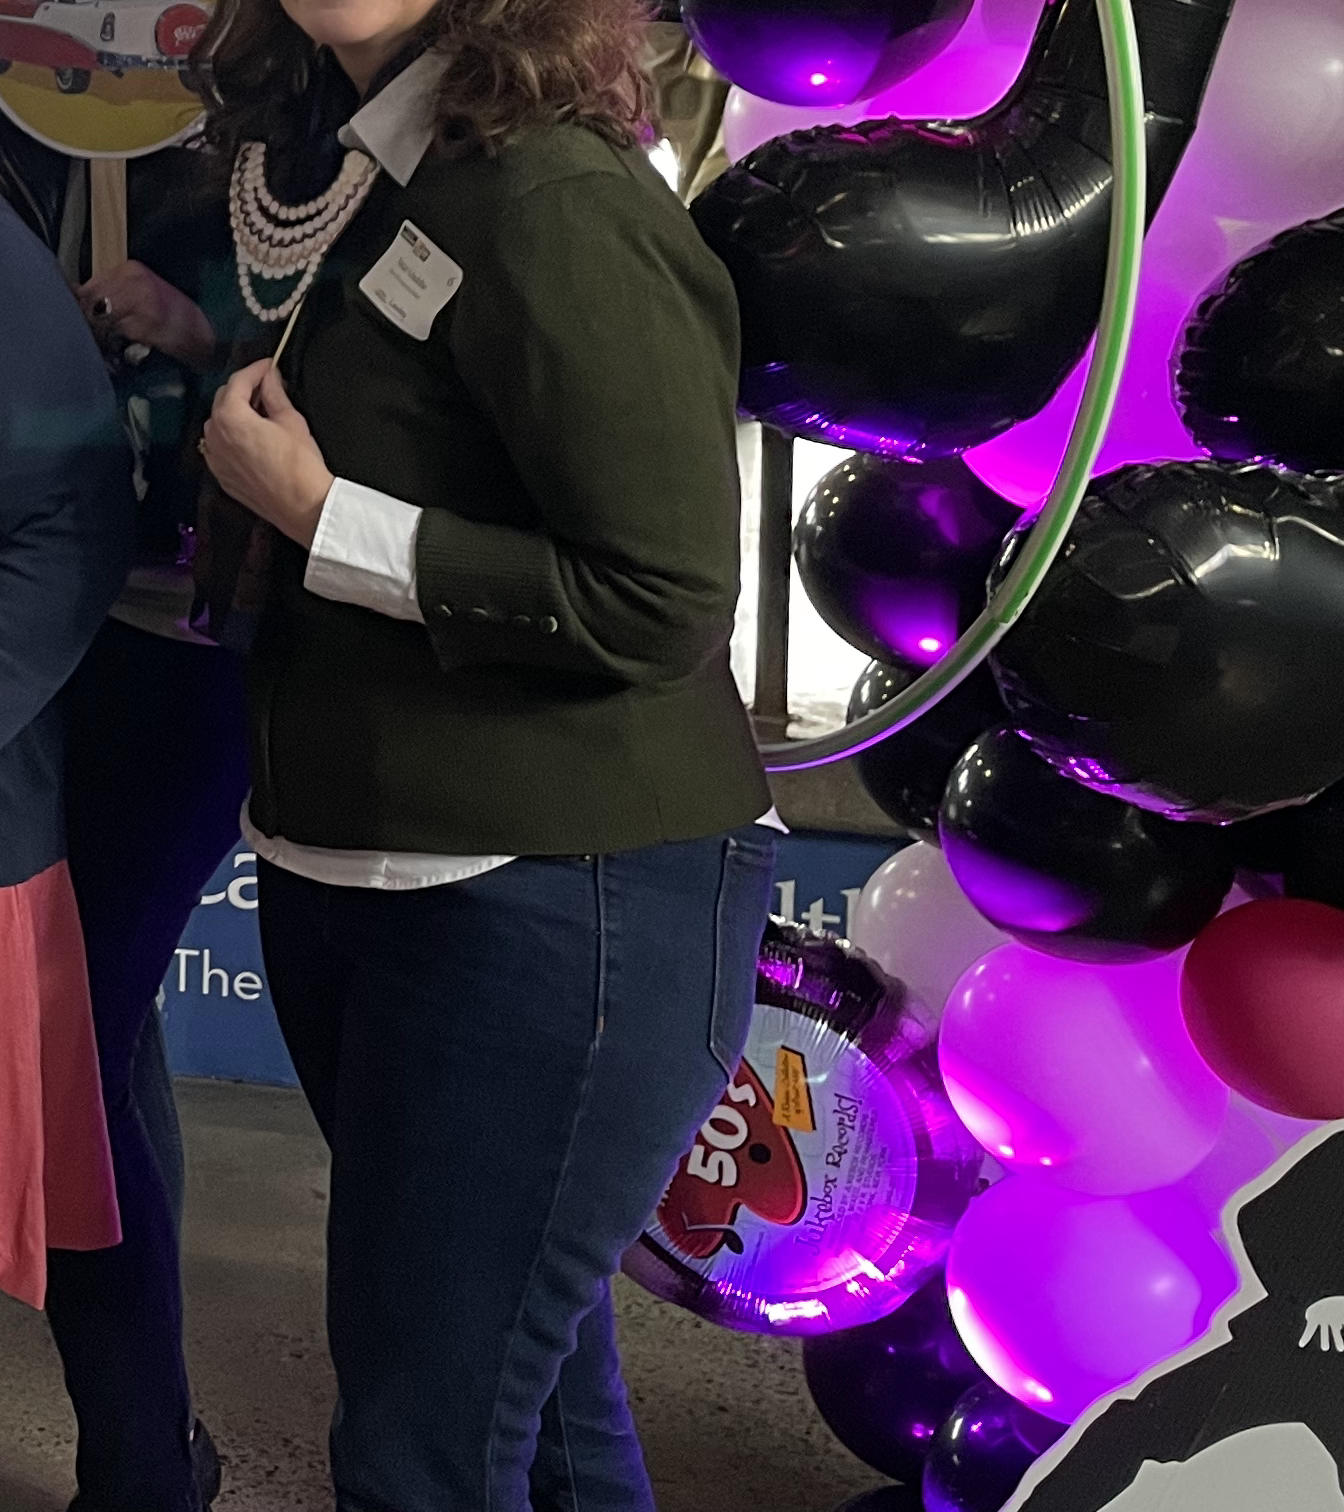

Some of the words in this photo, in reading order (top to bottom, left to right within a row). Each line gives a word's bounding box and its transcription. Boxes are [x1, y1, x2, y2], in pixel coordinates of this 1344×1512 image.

[174, 948, 263, 1000] The
[687, 1082, 758, 1188] 50s
[795, 1172, 840, 1257] Jukebox
[825, 1091, 864, 1172] Records!
